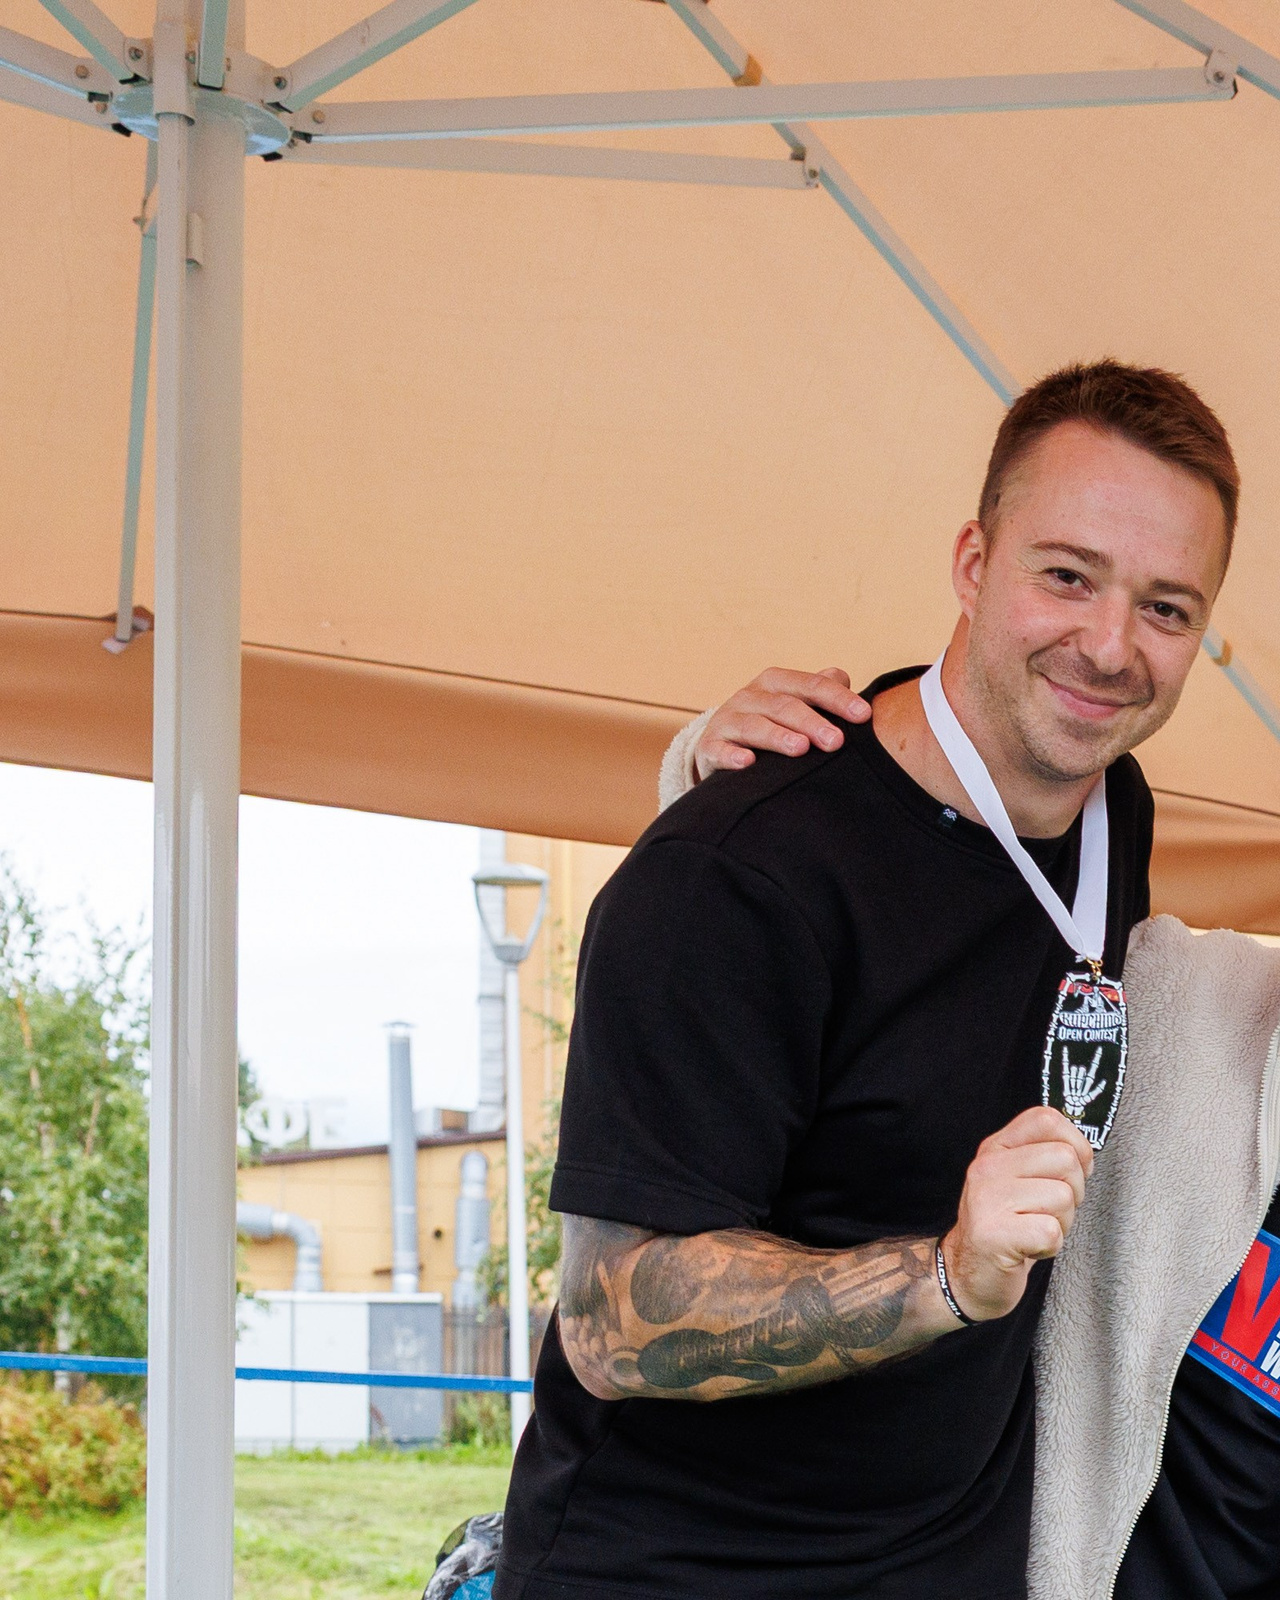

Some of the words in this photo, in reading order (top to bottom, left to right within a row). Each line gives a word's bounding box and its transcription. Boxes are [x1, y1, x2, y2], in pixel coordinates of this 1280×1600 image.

[1058, 1026, 1082, 1041] OPEN
[1083, 1028, 1119, 1044] CONTEST
[1211, 1342, 1248, 1374] YOUR
